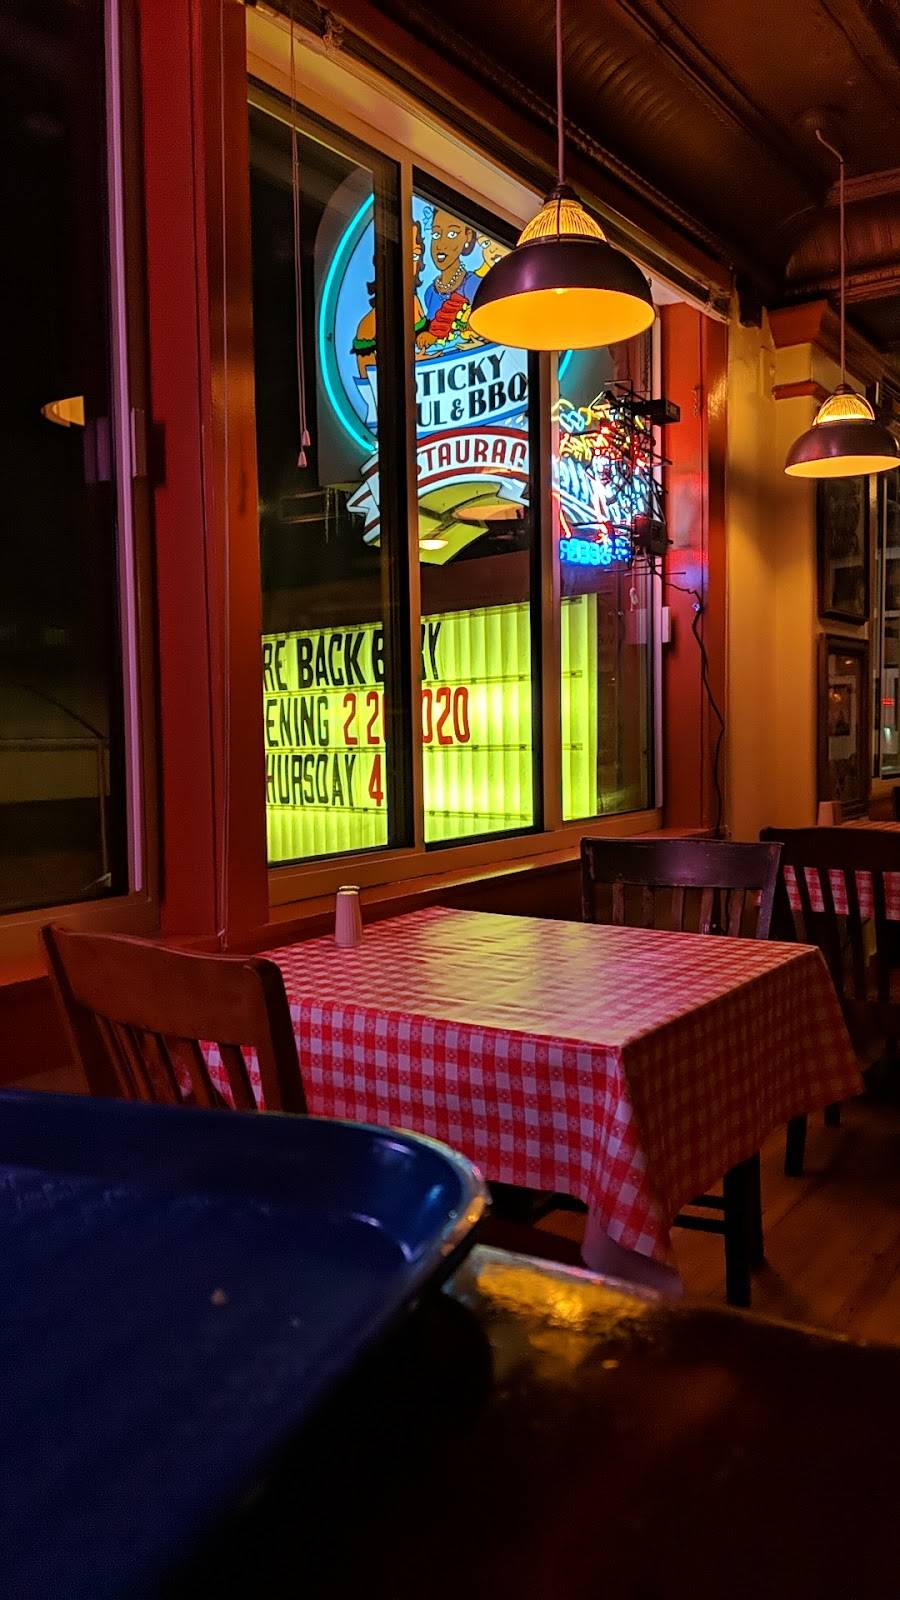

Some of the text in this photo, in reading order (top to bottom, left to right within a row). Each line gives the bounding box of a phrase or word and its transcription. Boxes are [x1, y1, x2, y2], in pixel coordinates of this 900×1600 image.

[416, 350, 506, 396] TICKY
[450, 398, 464, 421] &
[468, 371, 528, 419] BBQ
[296, 631, 366, 689] BACK
[343, 692, 358, 746] 2
[368, 753, 384, 807] 4
